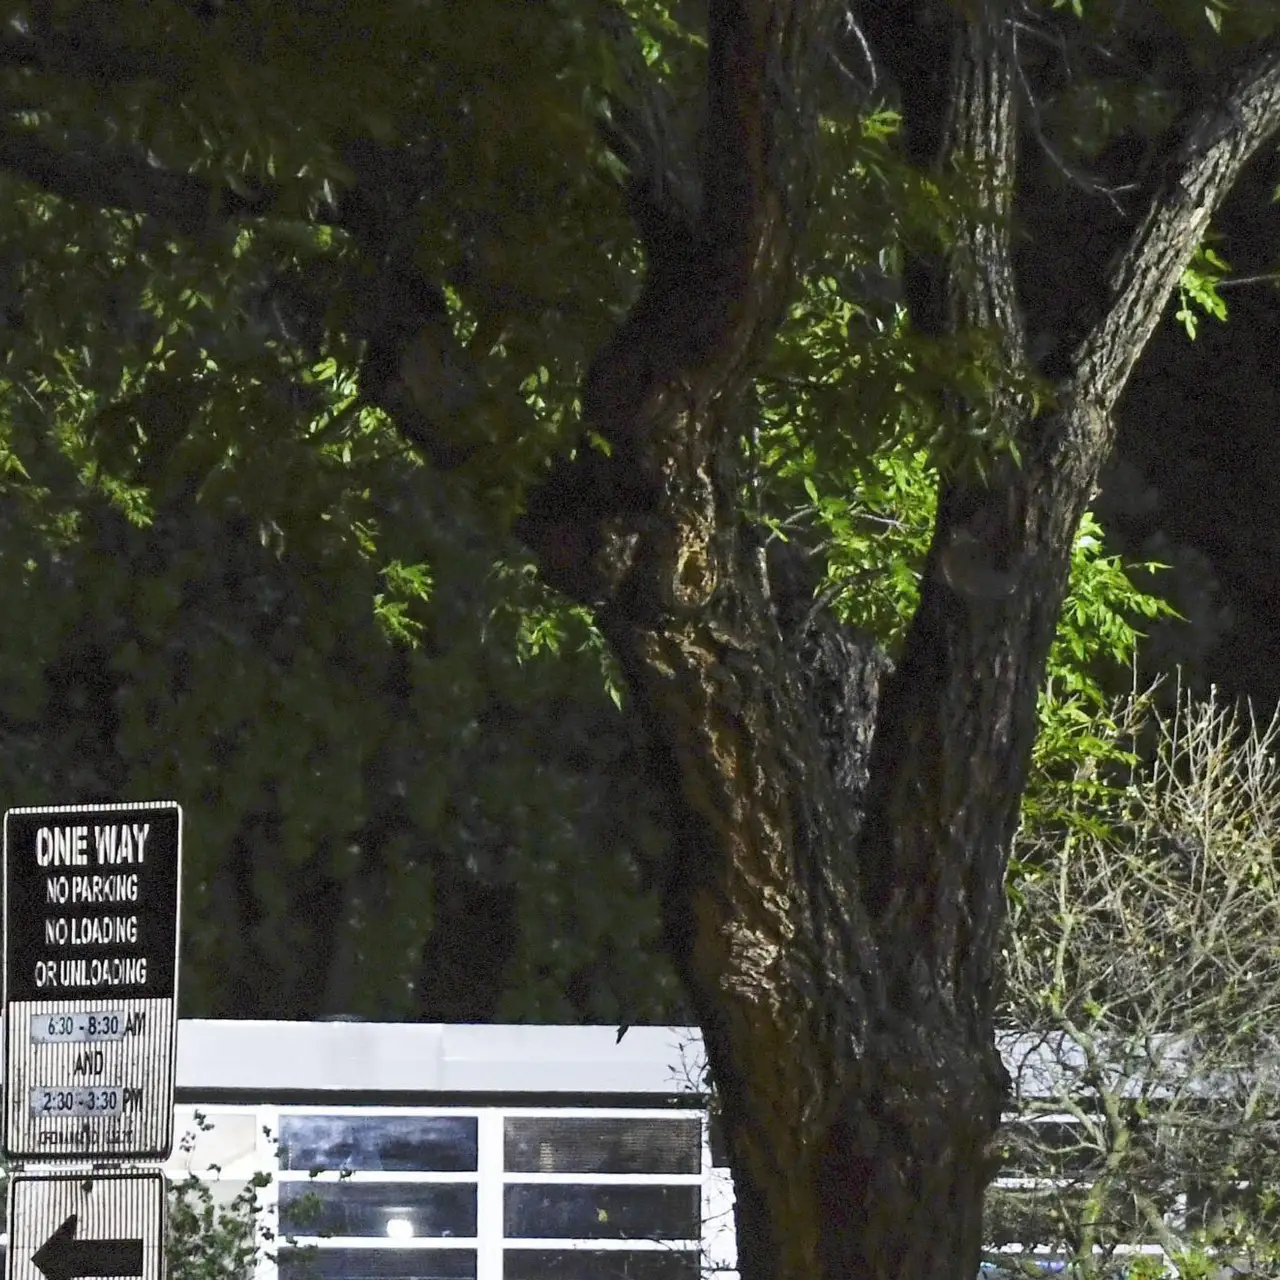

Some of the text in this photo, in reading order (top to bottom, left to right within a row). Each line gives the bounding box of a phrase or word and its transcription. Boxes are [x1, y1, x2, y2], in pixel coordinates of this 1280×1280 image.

[36, 823, 150, 867] ONE WAY
[46, 874, 138, 904] NO PARKING
[45, 916, 137, 945] NO LOADING
[35, 958, 147, 987] OR UNLOADING
[48, 1016, 74, 1035] 6:30
[88, 1016, 119, 1035] 8:30
[123, 1012, 146, 1037] AM
[74, 1050, 104, 1076] AND
[43, 1092, 74, 1111] 2:30
[87, 1091, 117, 1110] 3:30
[122, 1087, 144, 1113] PM
